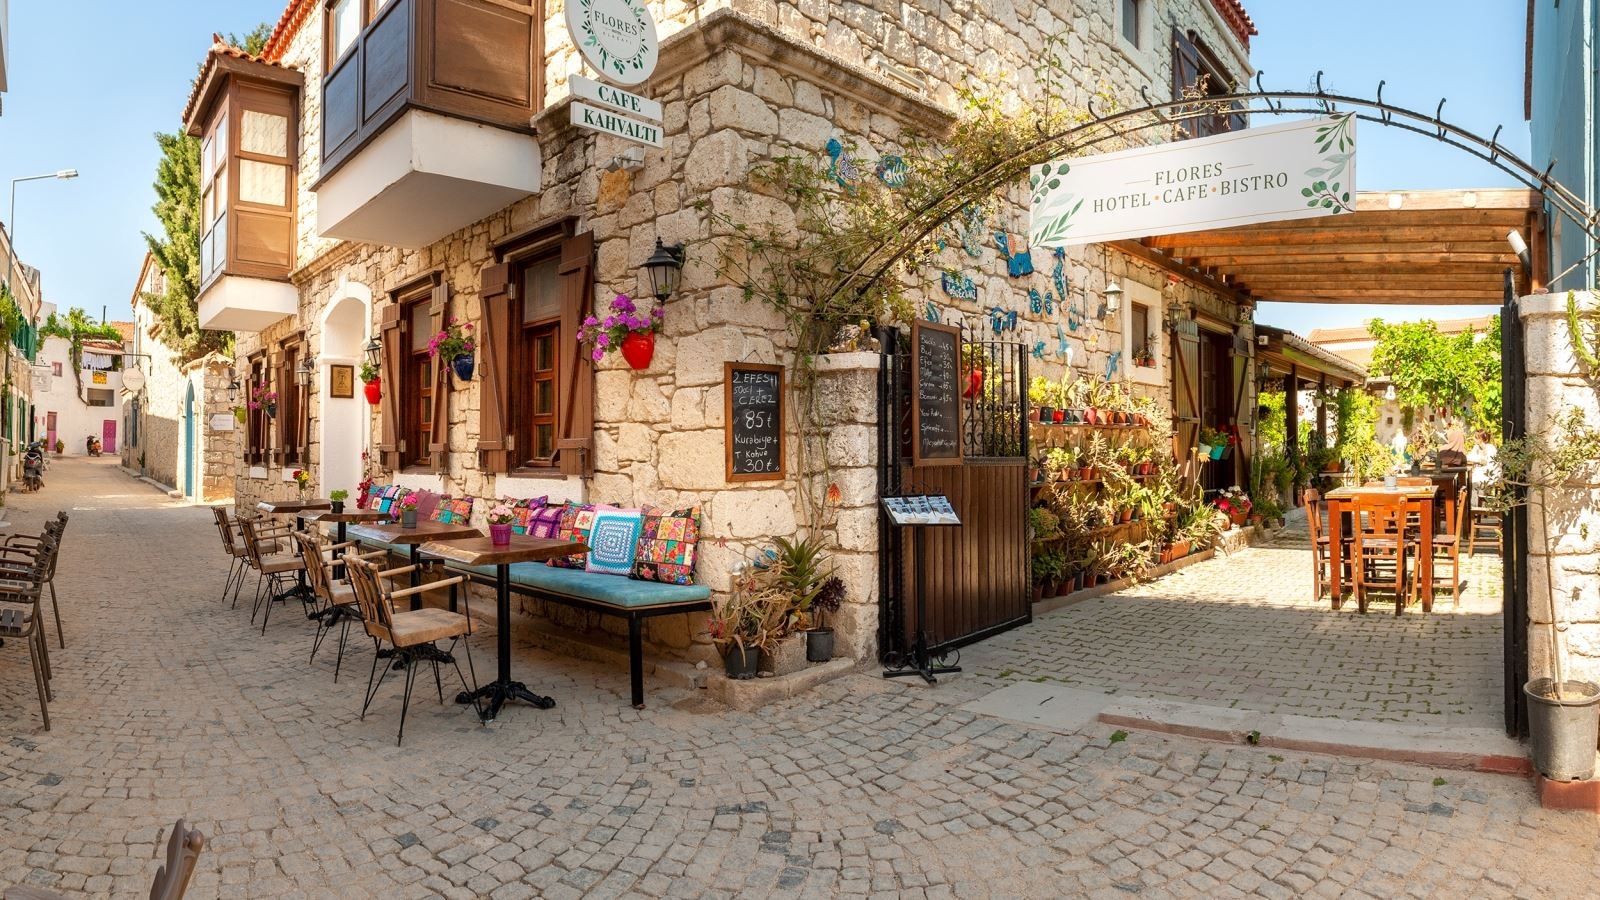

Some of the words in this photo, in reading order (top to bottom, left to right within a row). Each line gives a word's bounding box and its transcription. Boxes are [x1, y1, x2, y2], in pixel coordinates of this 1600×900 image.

[594, 10, 638, 36] FLORES
[598, 85, 641, 113] CAFE
[583, 108, 657, 143] KAHVALTI
[1154, 161, 1223, 186] FLORES
[1093, 193, 1151, 213] HOTEL
[1162, 184, 1208, 204] CAFE
[1220, 171, 1289, 196] BISTRO
[734, 433, 773, 450] Kurabiye
